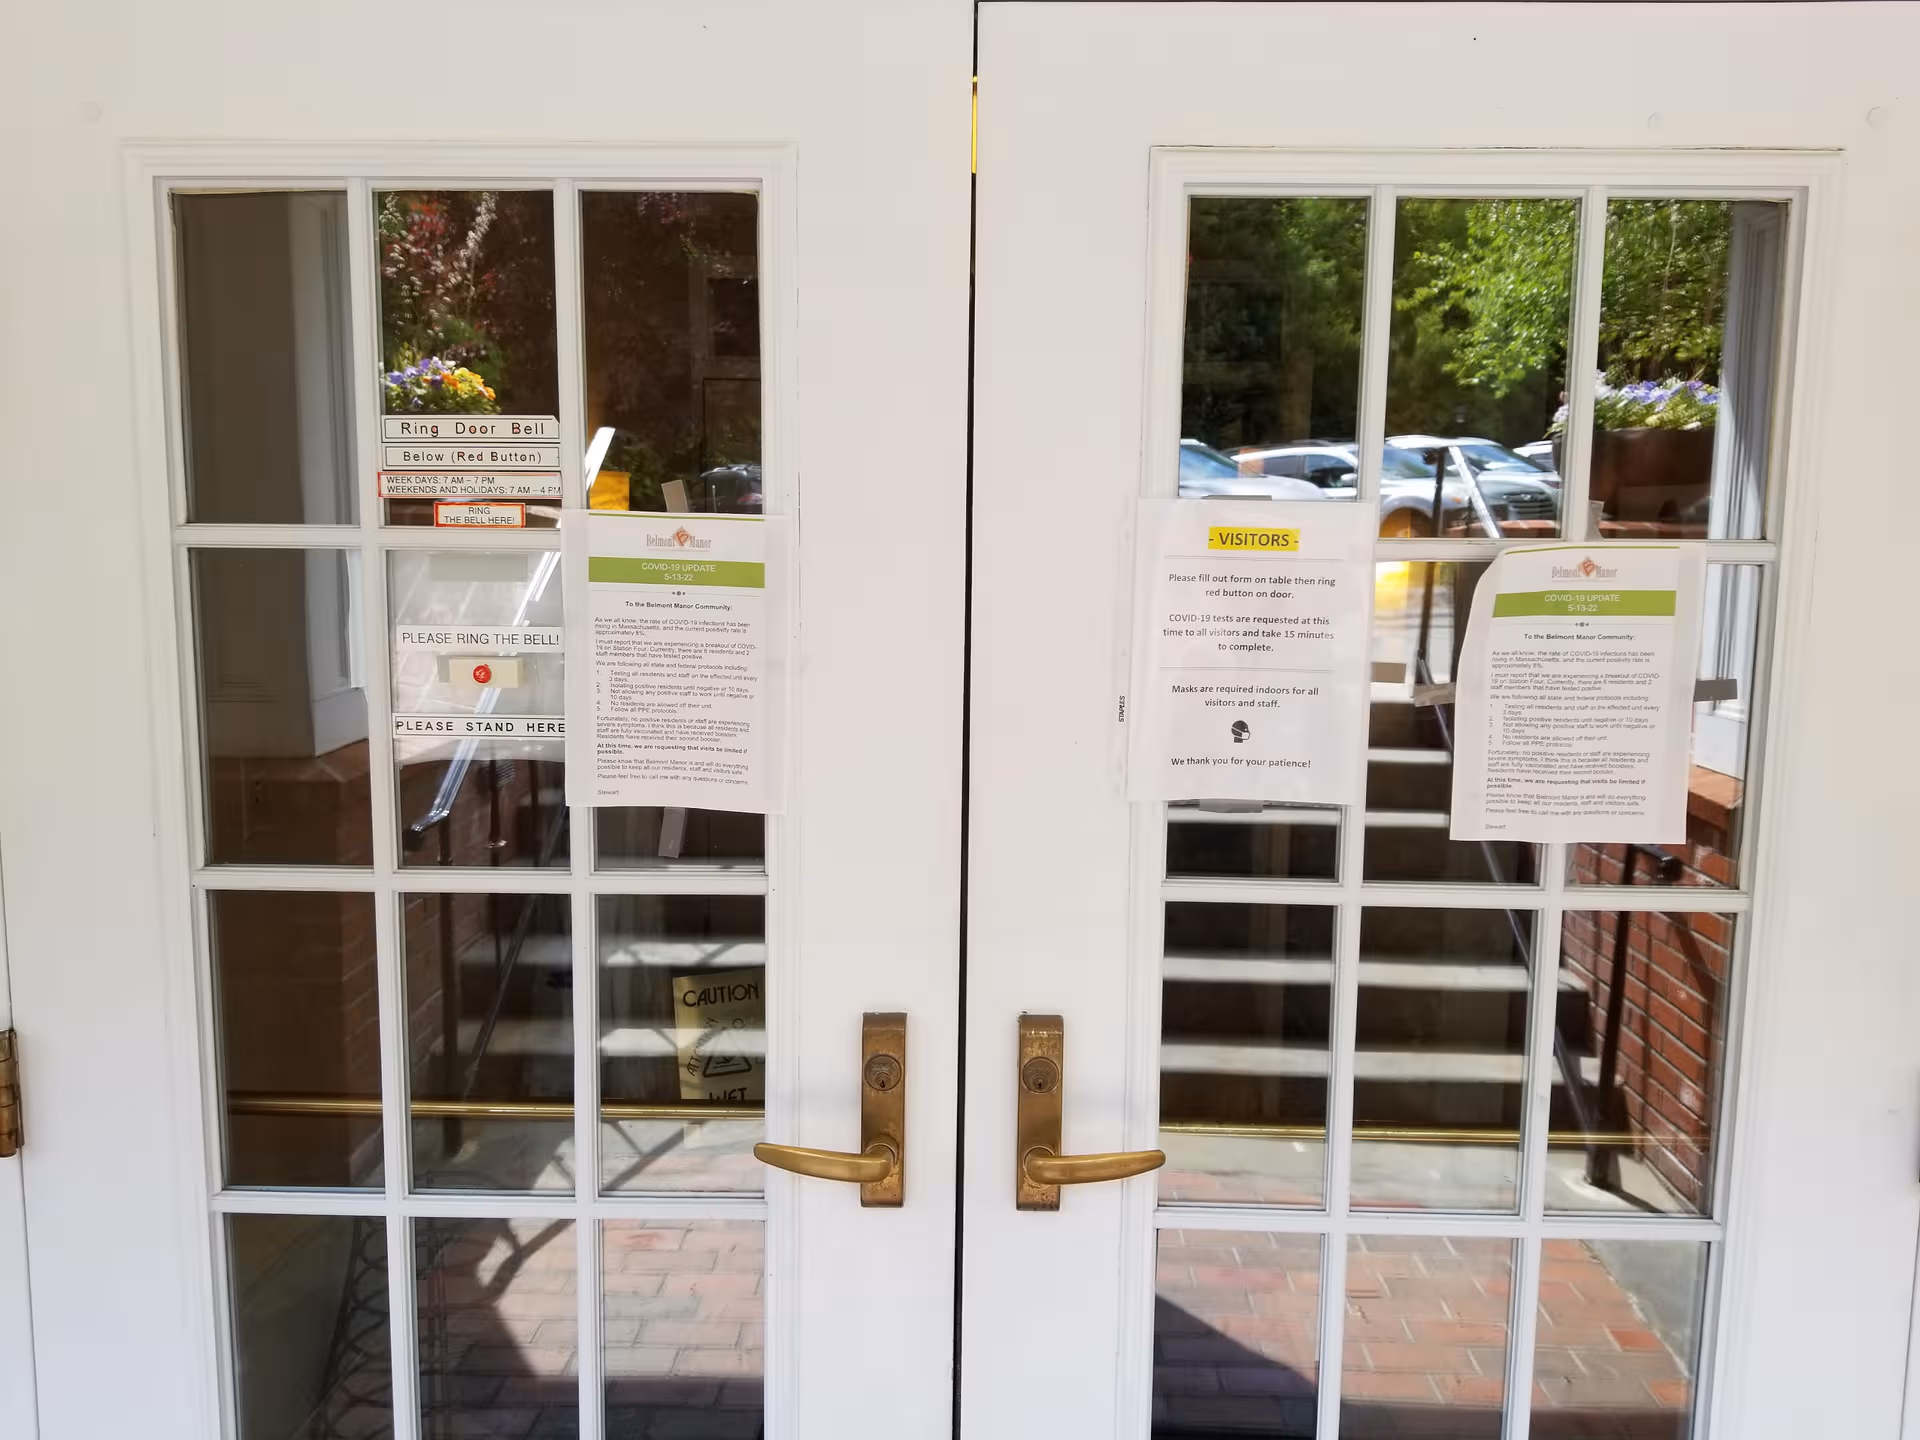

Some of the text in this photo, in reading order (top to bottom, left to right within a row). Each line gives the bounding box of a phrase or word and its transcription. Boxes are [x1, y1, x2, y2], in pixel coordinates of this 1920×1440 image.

[402, 422, 544, 437] Ring Door Bell
[404, 452, 542, 464] Below (Red Button)
[387, 486, 438, 494] WEEKENDS
[461, 486, 508, 494] HOLIDAYS:
[468, 507, 490, 515] RING
[444, 516, 462, 524] THE
[488, 516, 515, 524] HERE!
[646, 534, 712, 548] Belmont Manor
[1219, 532, 1290, 546] VISITORS
[642, 562, 716, 572] COVID-19 UPDATE
[664, 572, 694, 582] 5-13-22
[1168, 574, 1196, 582] Please
[1199, 574, 1210, 582] fill
[1212, 574, 1228, 583] out
[1230, 574, 1252, 584] form
[1268, 576, 1292, 584] table
[1294, 576, 1316, 585] then
[1318, 577, 1336, 587] ring
[1222, 589, 1254, 598] button
[1270, 590, 1294, 598] door.
[1544, 594, 1586, 602] COVID-19
[694, 604, 732, 612] Community:
[1568, 604, 1598, 612] 5-13-22
[1169, 614, 1211, 622] COVID-19
[1213, 614, 1234, 622] tests
[1252, 616, 1299, 627] requested
[1312, 616, 1330, 626] this
[402, 632, 559, 646] PLEASE RING THE BELL!
[1162, 628, 1183, 636] time
[1185, 629, 1194, 637] to
[1196, 628, 1207, 637] all
[1209, 628, 1240, 637] visitors
[1242, 629, 1260, 638] and
[1262, 630, 1282, 638] take
[1297, 630, 1334, 640] minutes
[1598, 634, 1636, 642] Community:
[1229, 643, 1274, 652] complete.
[1172, 684, 1198, 693] Masks
[1216, 685, 1254, 694] required
[1256, 686, 1290, 694] indoors
[1292, 686, 1306, 695] for
[1308, 688, 1319, 696] all
[1204, 698, 1280, 708] visitors and staff.
[396, 721, 566, 732] PLEASE STAND HERE
[1171, 757, 1312, 768] We thank you for your patience!
[682, 984, 759, 1008] CAUTION
[709, 1087, 747, 1104] WET
